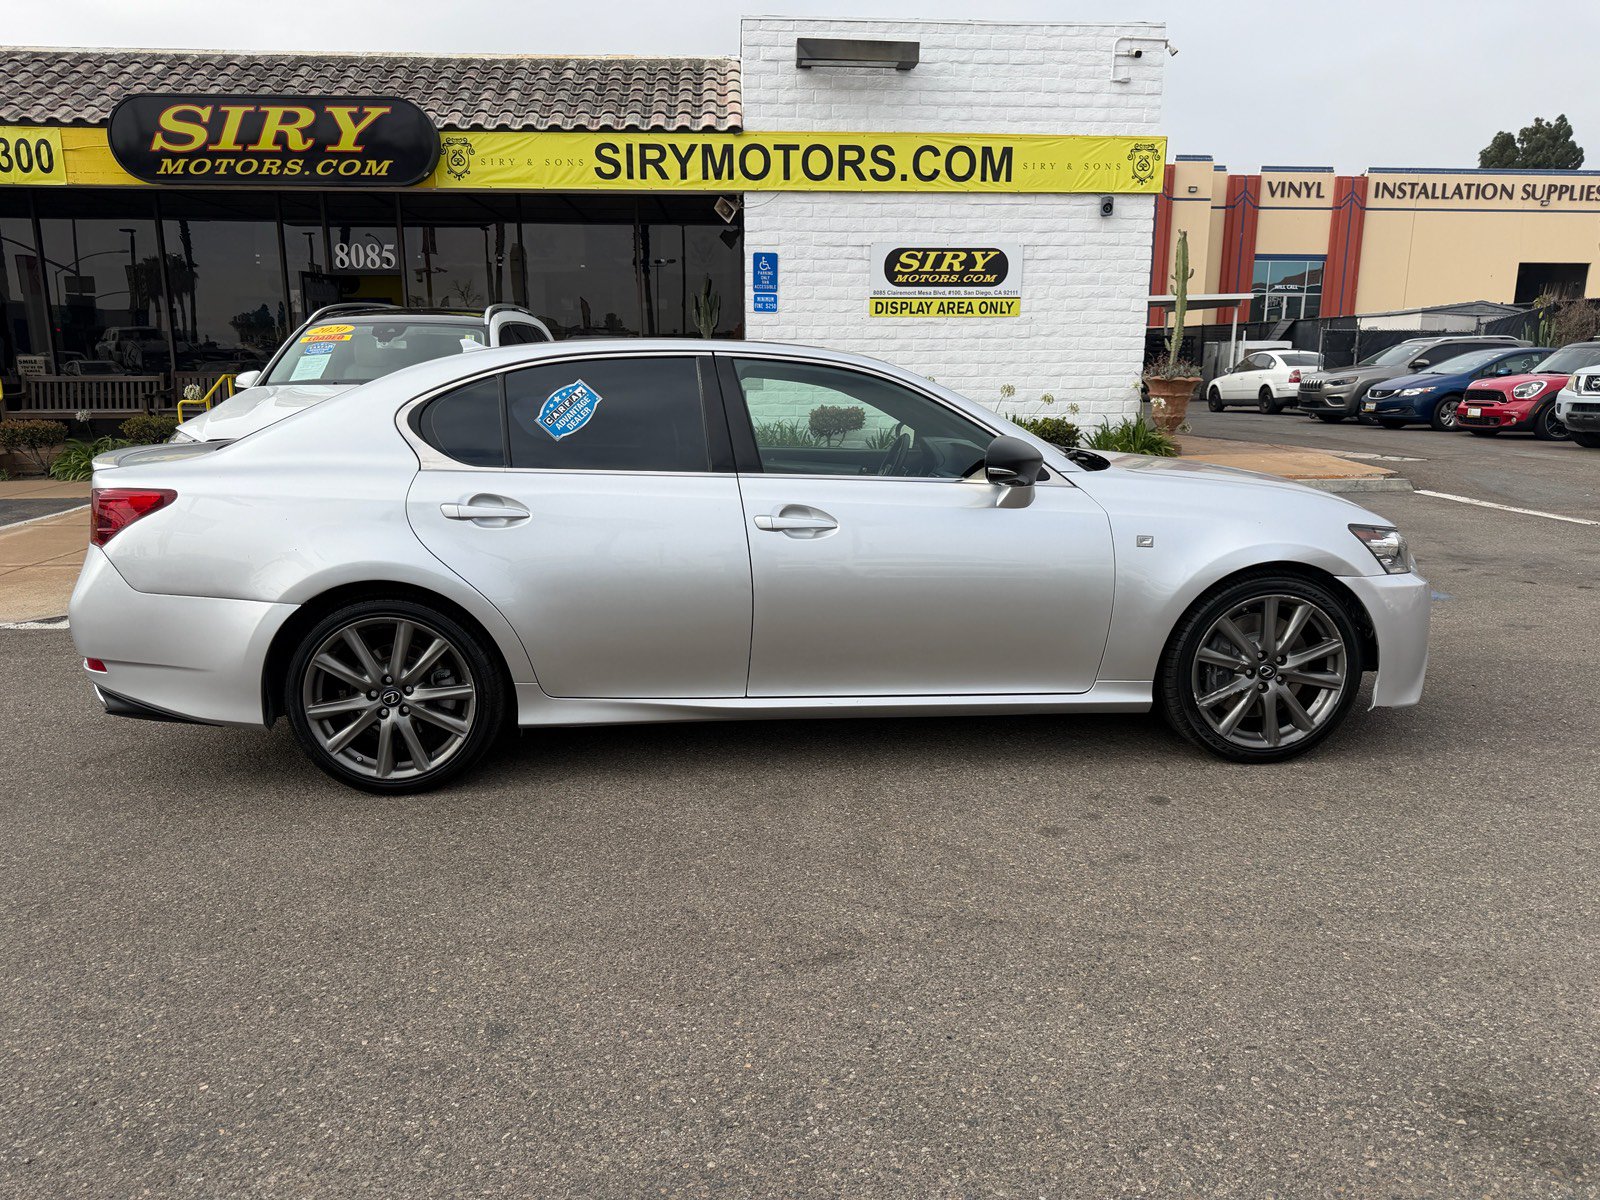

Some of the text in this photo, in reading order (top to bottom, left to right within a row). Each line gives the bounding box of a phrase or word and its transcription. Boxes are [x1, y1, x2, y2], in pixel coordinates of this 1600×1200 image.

[150, 104, 392, 153] SIRY
[0, 137, 54, 175] 300
[481, 158, 585, 167] SIRY & SONS
[594, 142, 1014, 183] SIRYMOTORS.COM
[156, 158, 393, 176] MOTORS.COM
[1022, 162, 1122, 171] SIRY & SONS
[1267, 181, 1326, 199] VINYL
[1374, 181, 1515, 201] INSTALLATION
[334, 243, 396, 269] 8085
[894, 251, 1000, 272] SIRY
[894, 274, 998, 283] MOTORS.COM
[975, 290, 993, 298] Diego,
[1003, 290, 1019, 298] 92111
[874, 301, 1015, 315] DISPLAY AREA ONLY
[544, 388, 587, 426] CARFAX
[555, 395, 592, 431] ADVANTAGE
[566, 406, 592, 431] DEALER
